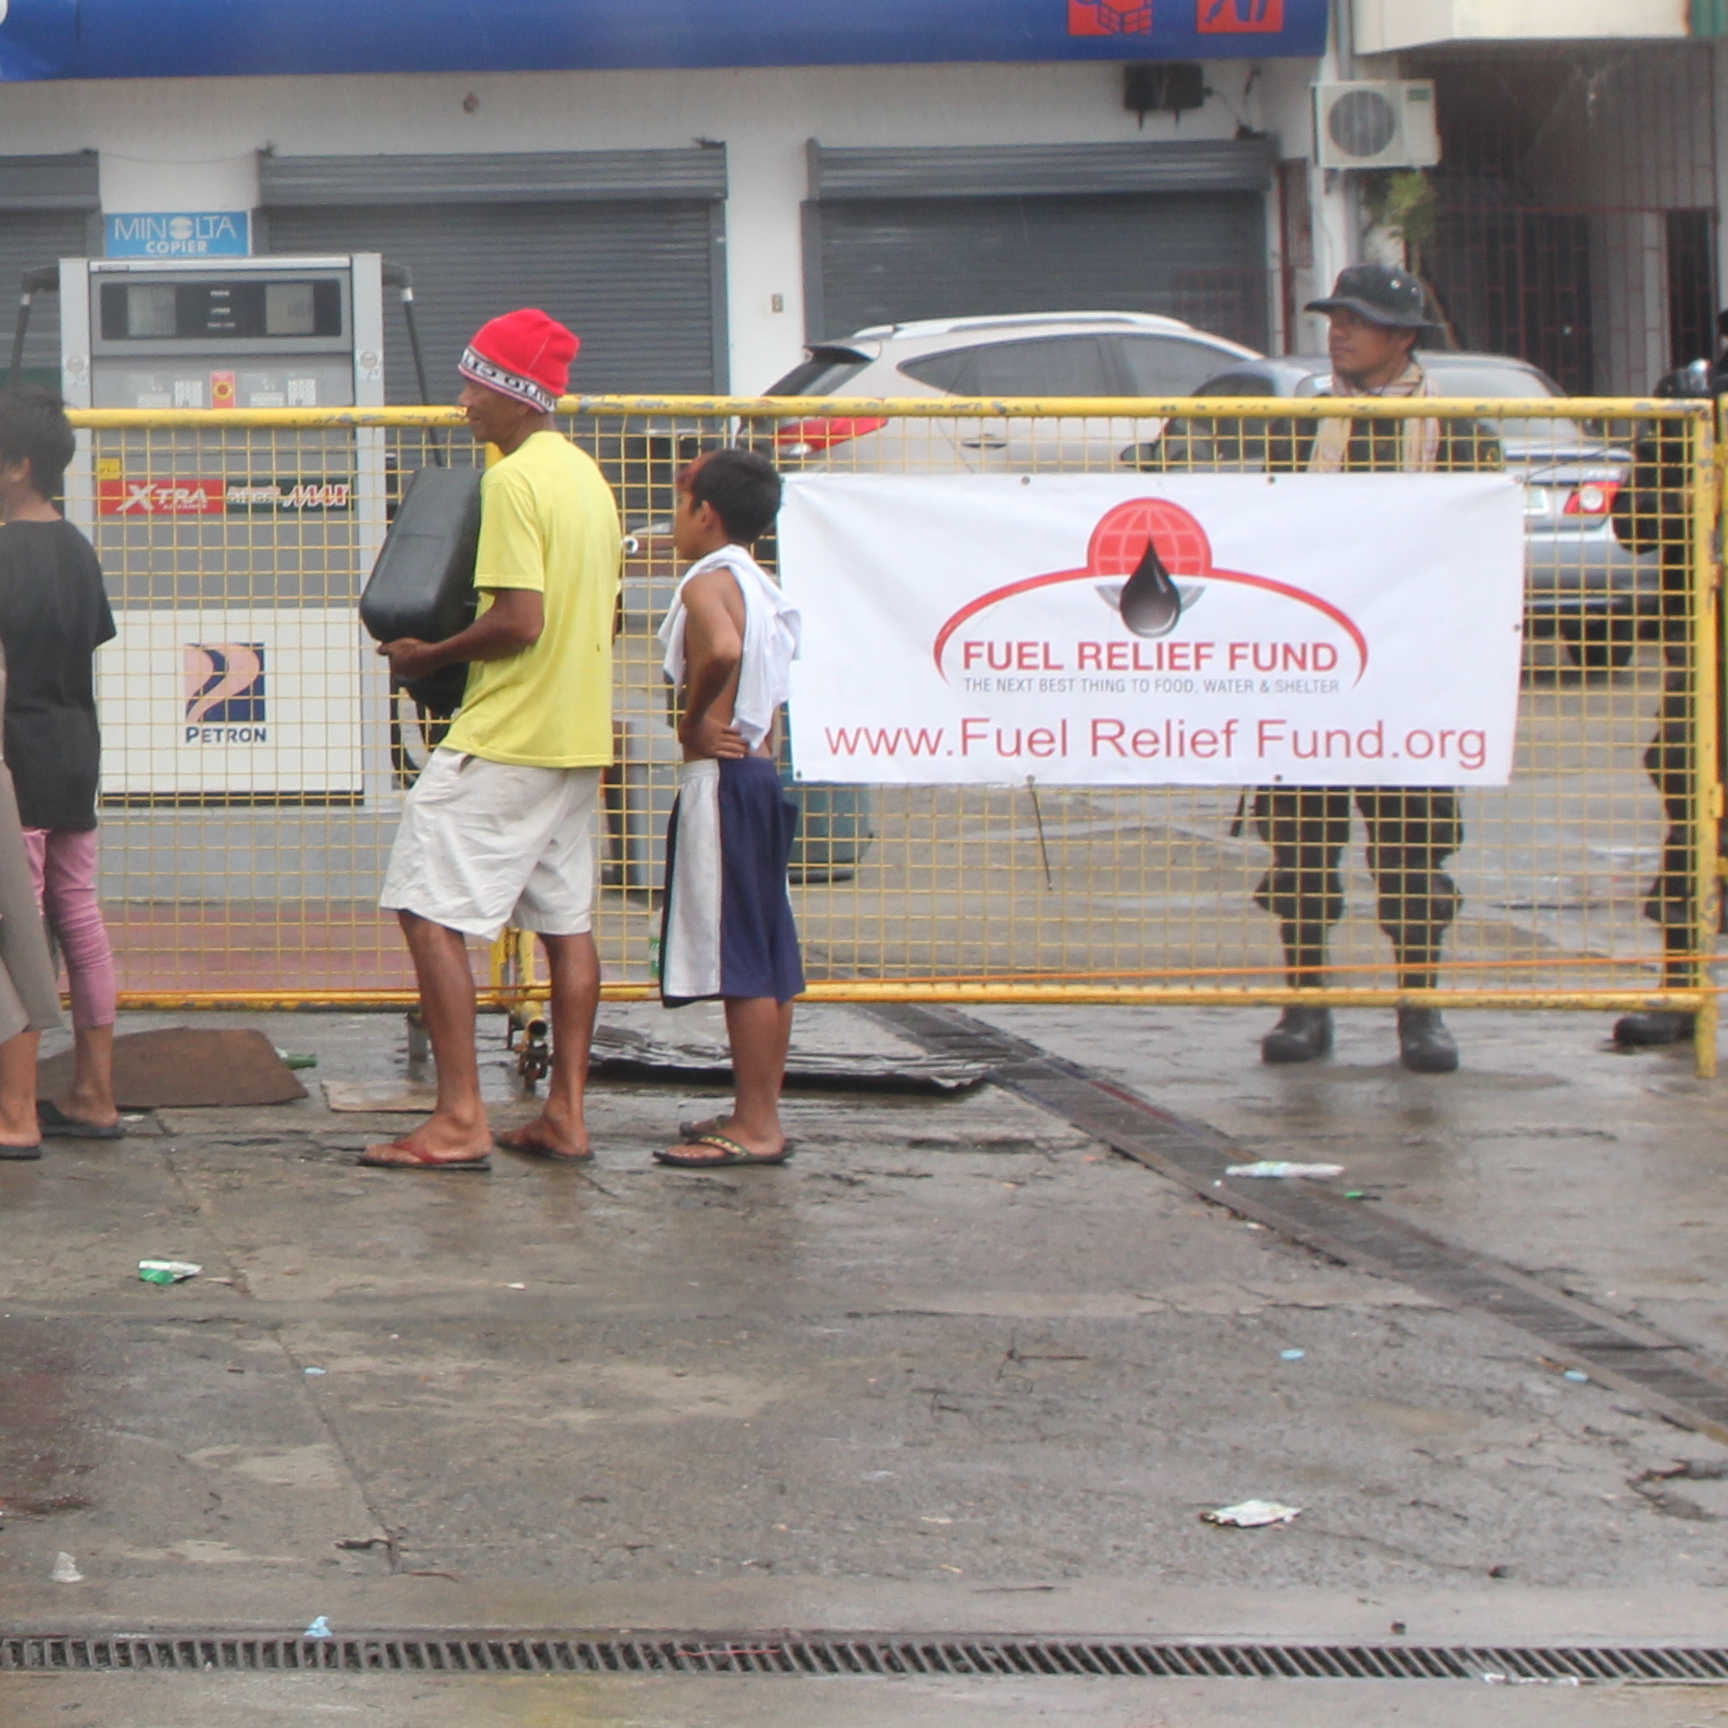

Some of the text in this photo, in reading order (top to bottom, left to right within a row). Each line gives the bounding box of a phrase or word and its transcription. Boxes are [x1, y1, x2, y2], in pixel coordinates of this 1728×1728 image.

[146, 240, 208, 254] COPIER
[963, 641, 1338, 672] FUEL RELIEF FUND
[964, 678, 992, 693] THE
[996, 678, 1033, 693] NEXT
[1040, 678, 1076, 693] BEST
[1082, 678, 1125, 693] THING
[1132, 679, 1150, 693] TO
[1204, 679, 1254, 693] WATER
[1259, 679, 1270, 694] &
[1275, 679, 1340, 694] SHELTER
[186, 726, 266, 743] PETRON
[825, 718, 1487, 771] www.Fuel Relief Fund.org
